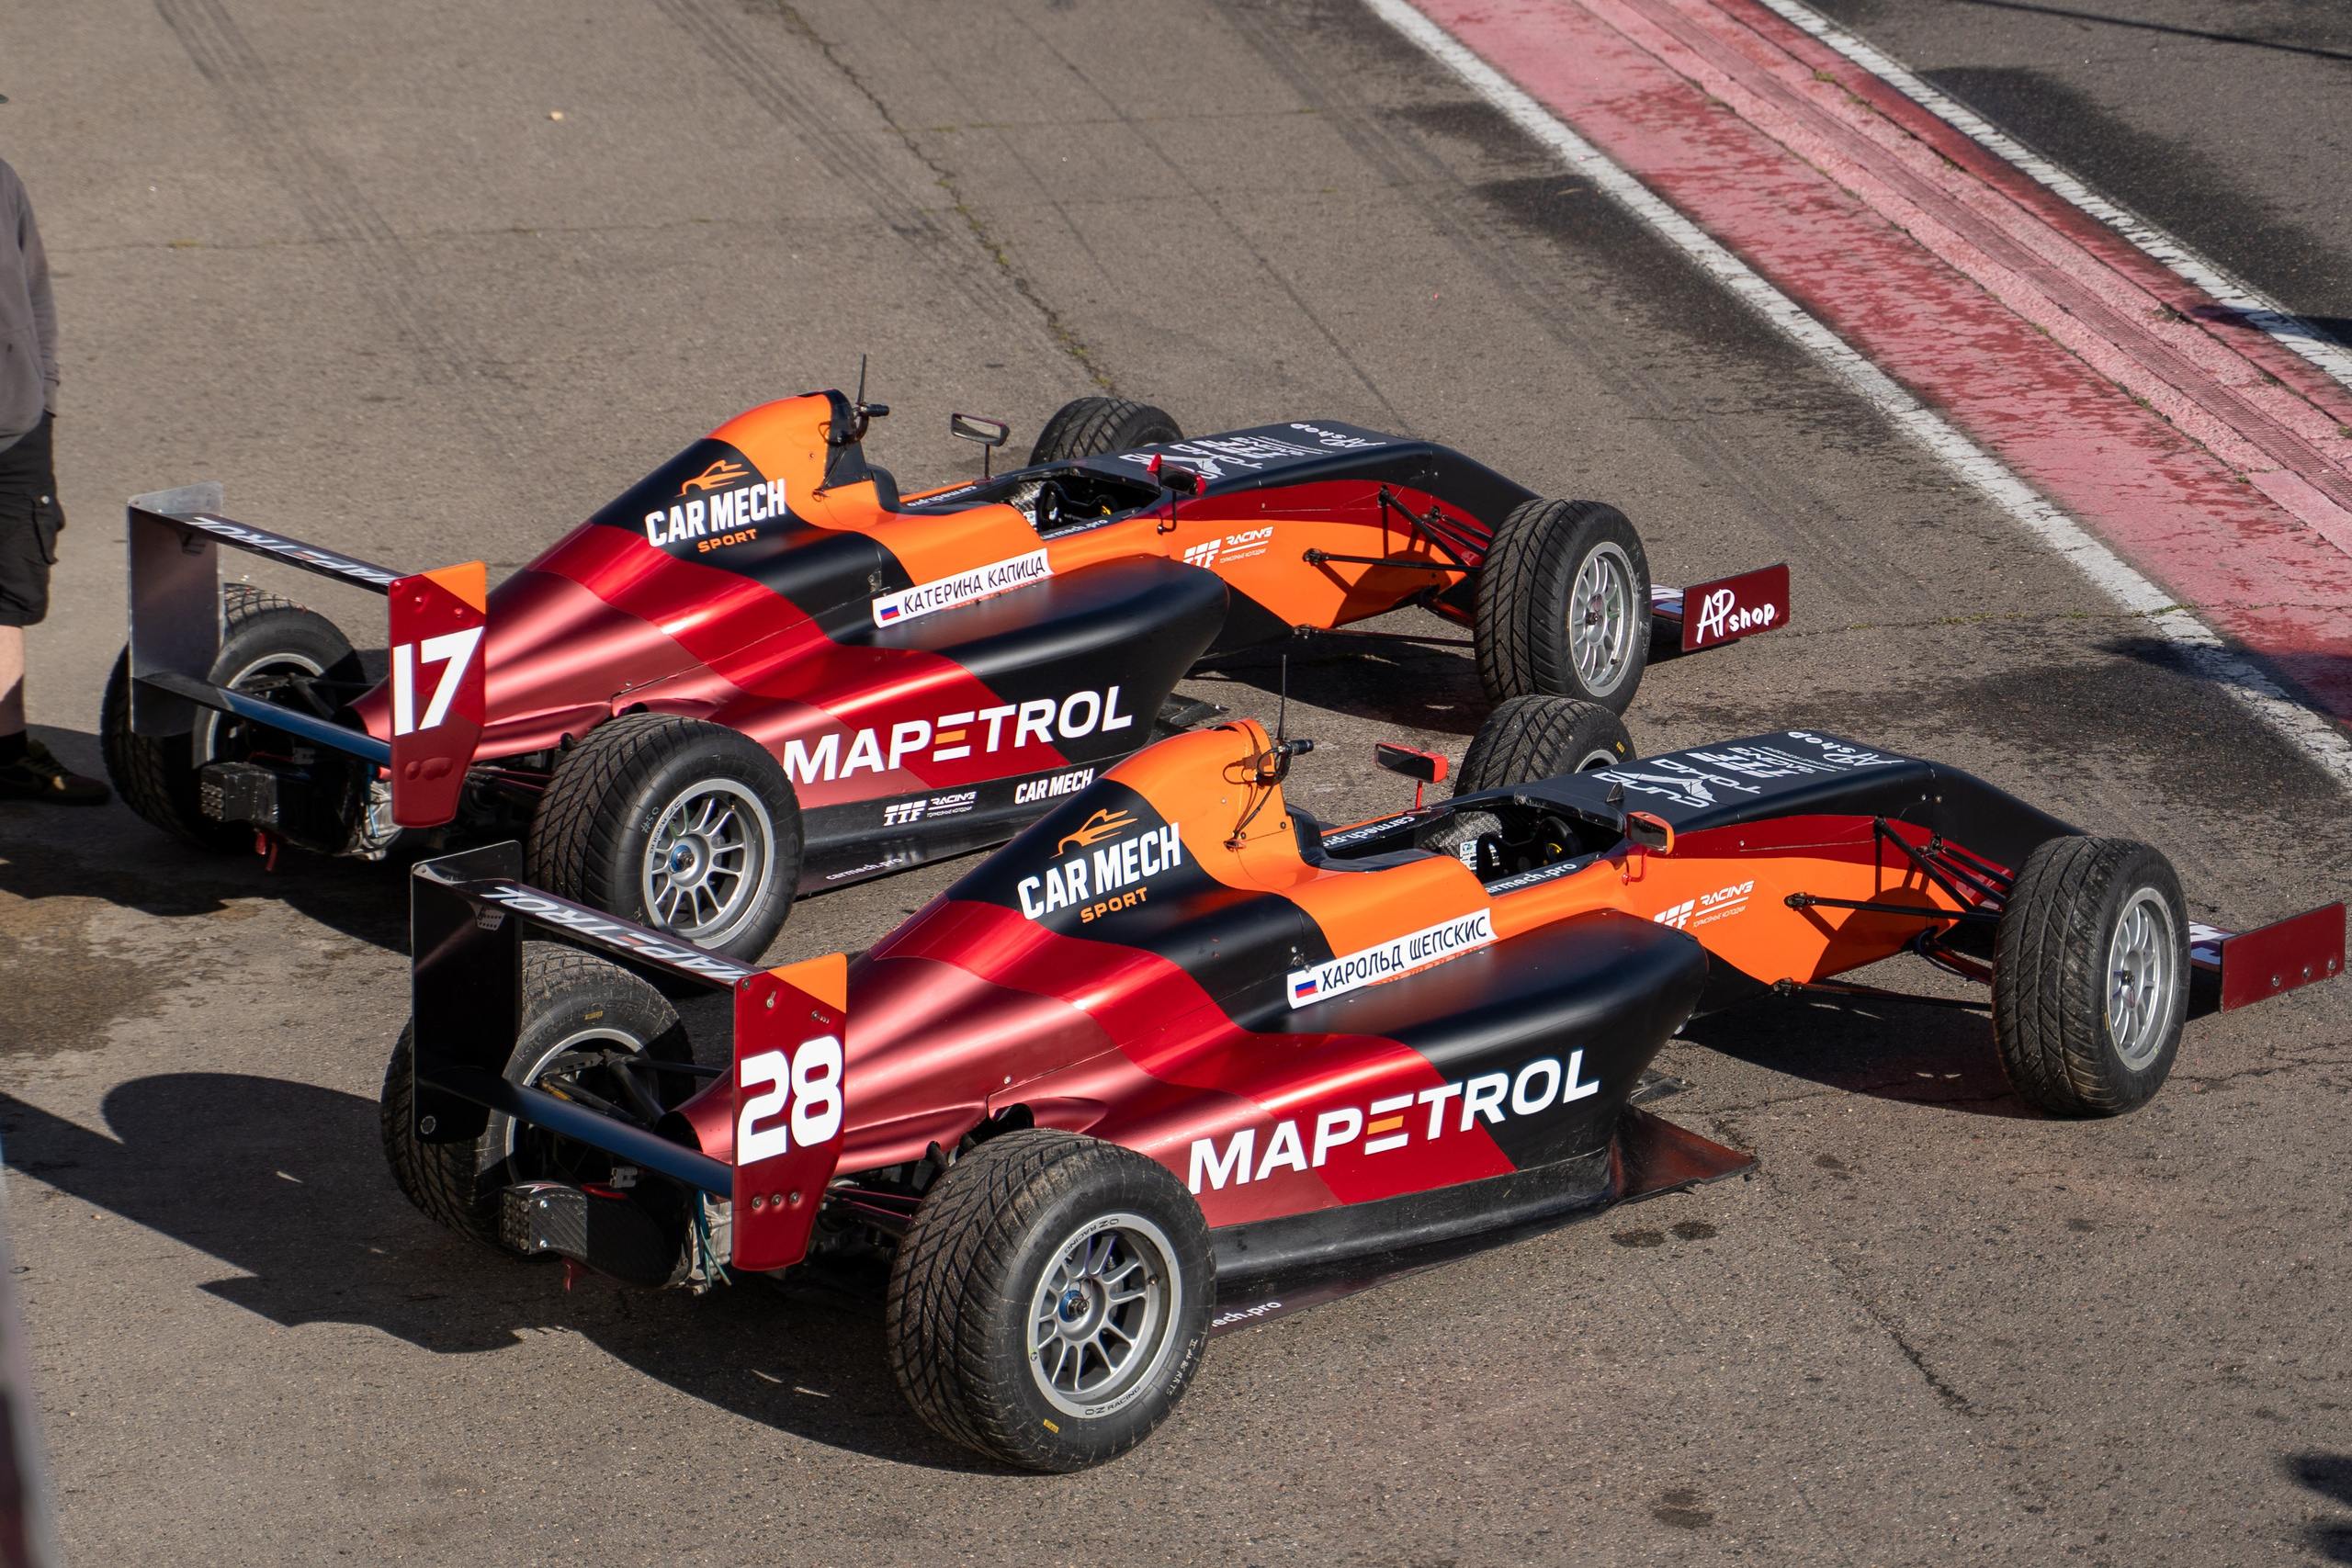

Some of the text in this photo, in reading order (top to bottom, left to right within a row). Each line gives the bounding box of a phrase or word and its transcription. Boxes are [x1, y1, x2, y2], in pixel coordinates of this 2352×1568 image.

[645, 478, 786, 547] CAR MECH
[697, 528, 757, 553] SPORT
[1226, 526, 1273, 545] RACING
[904, 556, 1046, 614] КАТЕРИНА КАПИЦА
[392, 626, 484, 736] 17
[784, 685, 1133, 784] MAPETROL
[1014, 767, 1094, 805] CAR MECH
[883, 791, 977, 826] TTF RACING
[826, 858, 903, 880] carmech.pro
[1017, 822, 1182, 920] CAR MECH
[1485, 863, 1577, 894] armech.pro
[1080, 886, 1148, 924] SPORT
[1700, 880, 1755, 906] RACING
[480, 886, 749, 985] MAPETROL
[1321, 916, 1487, 992] ХАРОЛЬД ШЕПСКИС
[738, 1034, 842, 1167] 28
[1188, 1048, 1600, 1195] MAPETROL
[1065, 1225, 1097, 1254] RACING
[1107, 1386, 1141, 1411] RACING
